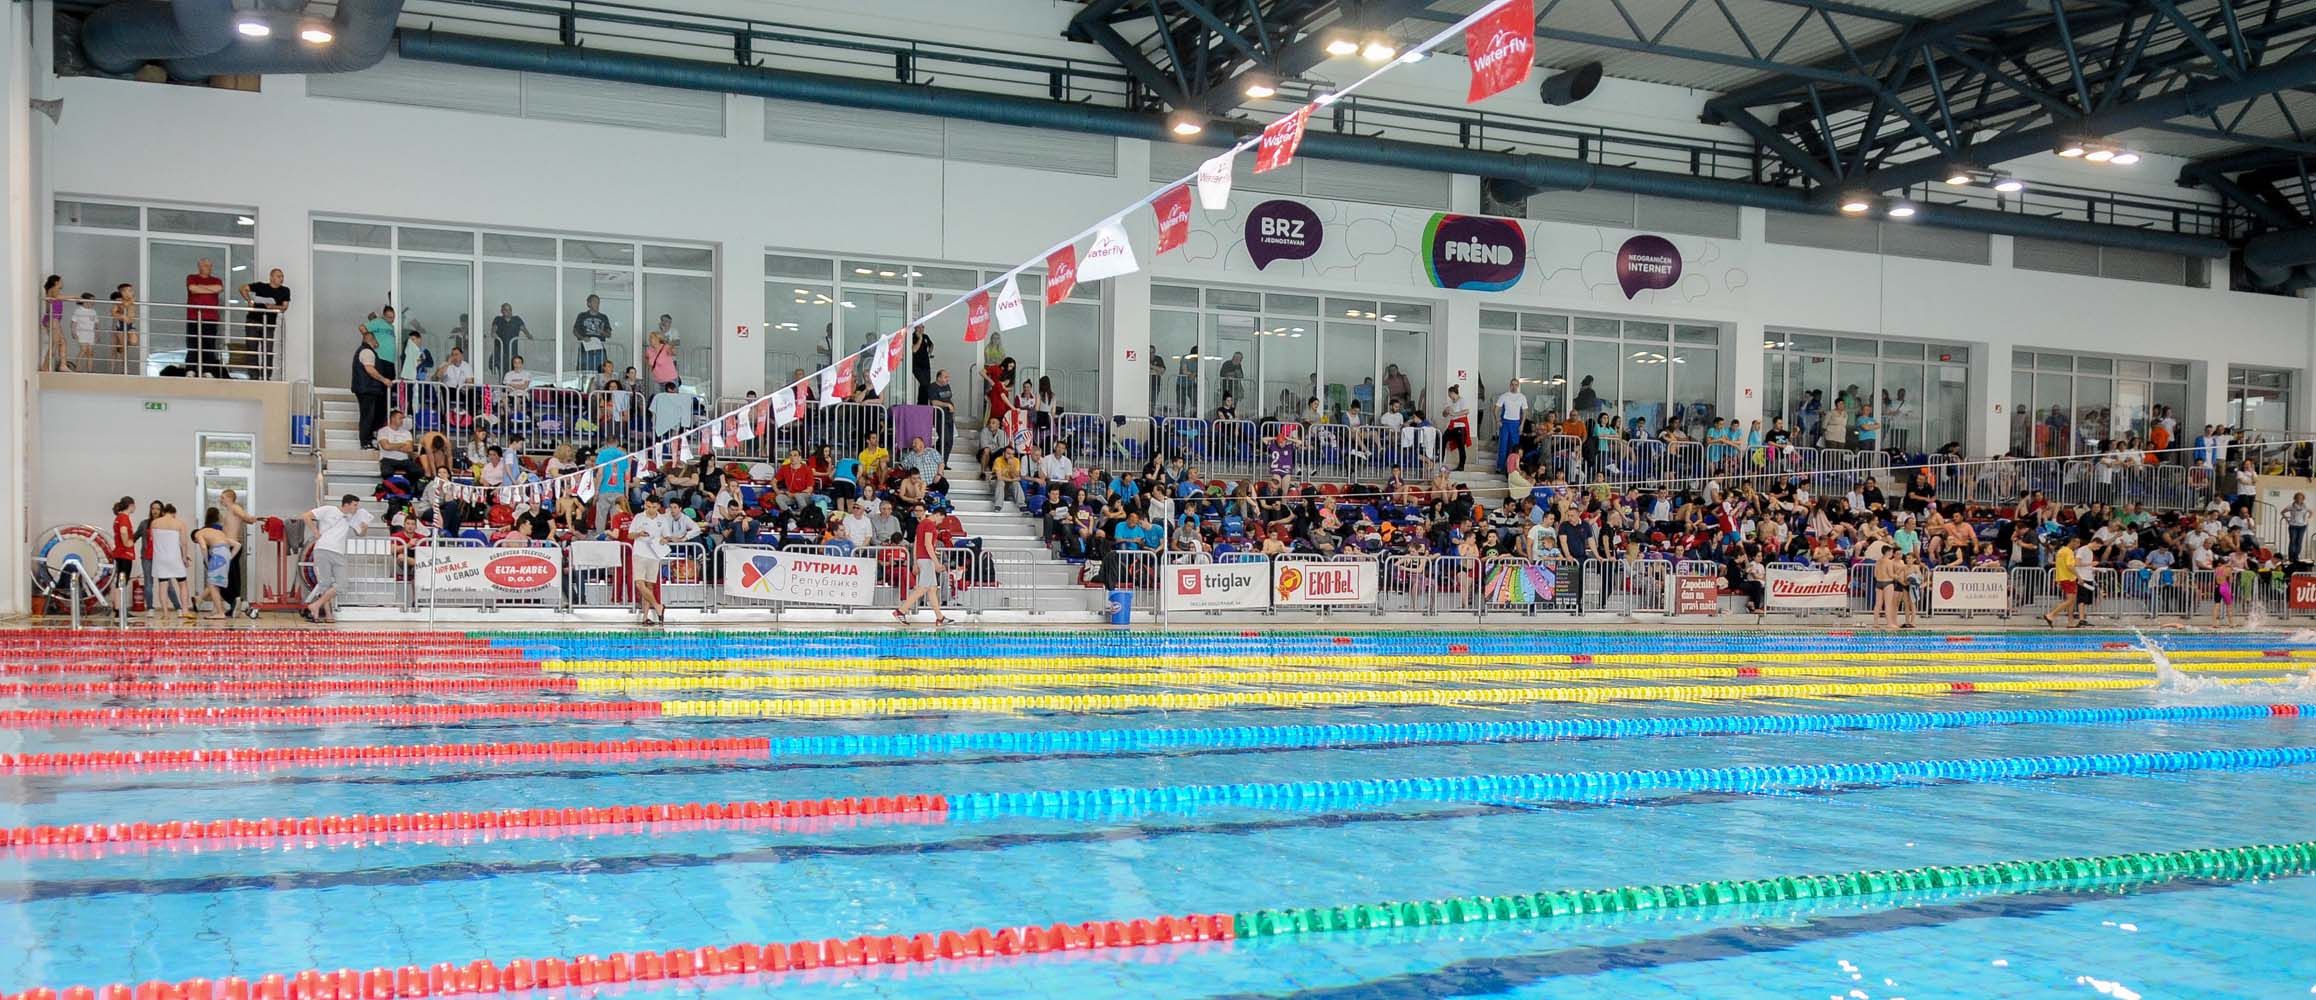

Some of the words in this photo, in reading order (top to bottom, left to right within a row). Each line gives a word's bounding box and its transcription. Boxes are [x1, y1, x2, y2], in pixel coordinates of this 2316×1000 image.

[1474, 37, 1527, 72] Waterfly
[1263, 131, 1296, 148] Water
[1160, 210, 1190, 233] Waterfly
[1261, 217, 1305, 239] BRZ
[1265, 237, 1305, 246] JEDNOSTAVAN
[1628, 254, 1672, 264] NEOGRANIČEN
[1628, 262, 1673, 275] INTERNET
[1271, 451, 1280, 469] 2
[446, 574, 452, 582] U
[453, 568, 480, 580] GRADU
[496, 565, 549, 574] ELTA-KABEL
[791, 560, 859, 576] ЛУТРИЈА
[791, 574, 859, 588] Републике
[1204, 572, 1251, 592] triglav
[1772, 580, 1847, 595] Vitaminka
[1960, 582, 2003, 592] ТОПЛАНА
[790, 585, 859, 598] Српске
[1681, 590, 1695, 600] dan
[1696, 592, 1705, 600] na
[1681, 600, 1699, 613] pravi
